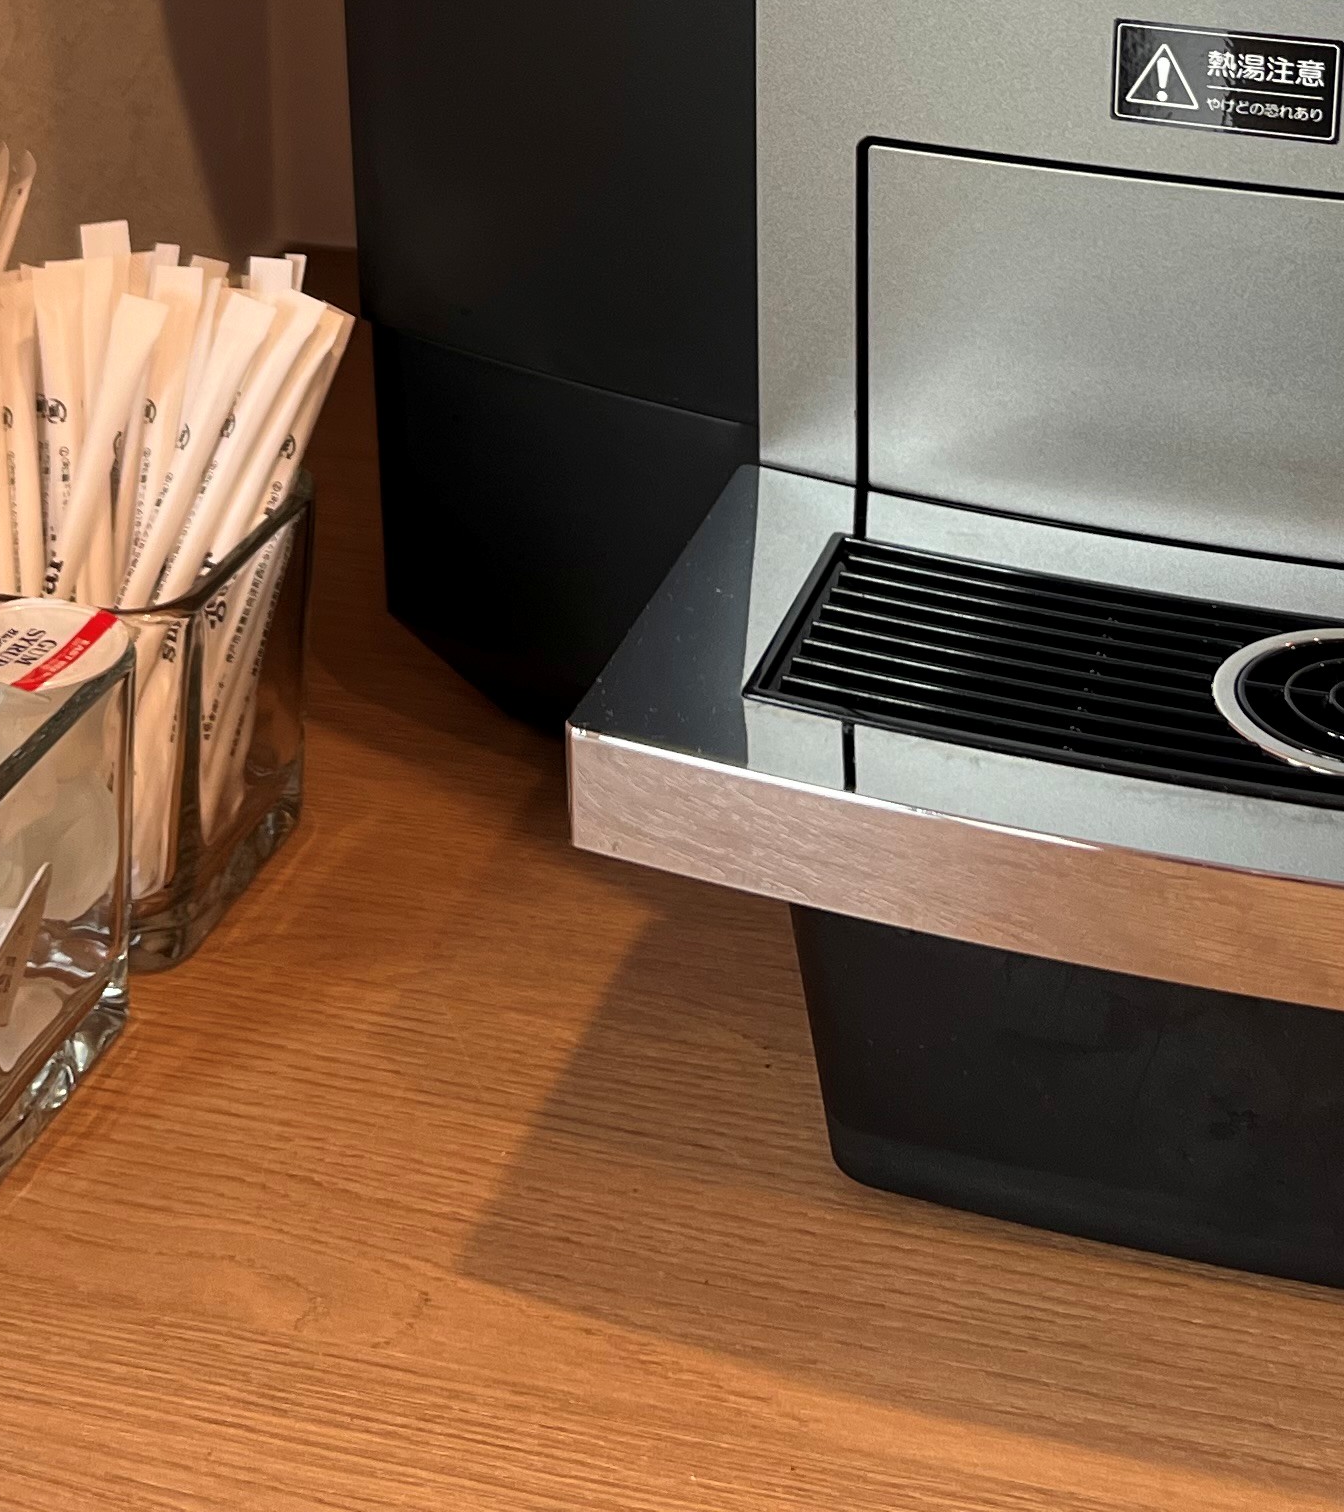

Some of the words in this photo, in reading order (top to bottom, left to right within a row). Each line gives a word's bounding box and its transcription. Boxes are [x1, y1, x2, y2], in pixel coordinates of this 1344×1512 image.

[1207, 49, 1326, 88] 熱湯注意
[1206, 96, 1323, 123] やけどの恐れあり
[14, 638, 58, 667] GUM
